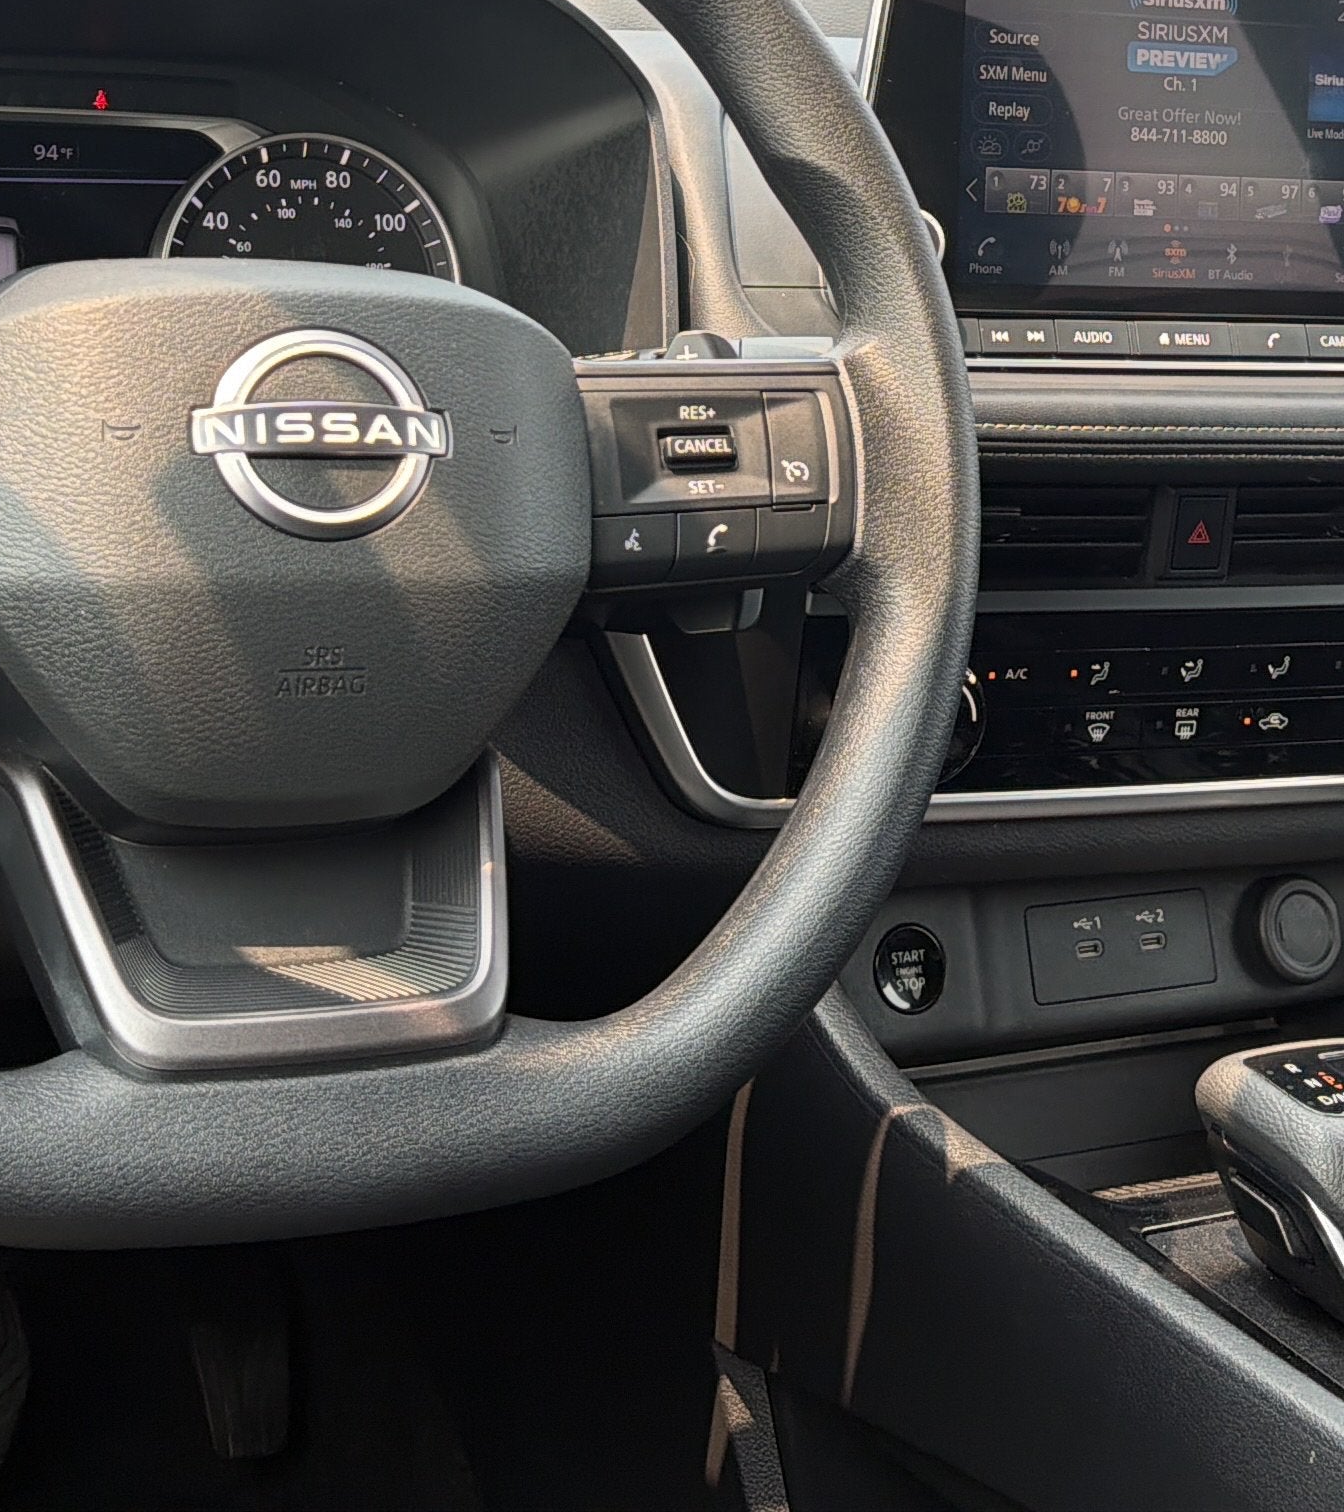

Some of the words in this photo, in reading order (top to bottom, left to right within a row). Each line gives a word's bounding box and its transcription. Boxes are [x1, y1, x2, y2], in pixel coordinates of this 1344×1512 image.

[989, 29, 1040, 46] Source
[1138, 21, 1228, 44] SIRIUSXM
[1136, 49, 1228, 70] PREVIEW
[979, 65, 1008, 80] SXM
[1011, 67, 1047, 83] Menu
[1164, 77, 1186, 92] Ch.
[1191, 78, 1197, 92] 1
[989, 102, 1031, 121] Replay
[1118, 106, 1157, 122] Great
[1162, 108, 1200, 124] Offer
[1205, 110, 1241, 126] Now!
[1130, 127, 1228, 146] 844-711-8800
[1307, 128, 1323, 140] Live
[256, 169, 281, 188] 60
[290, 179, 317, 190] MPH
[325, 171, 351, 188] 80
[993, 176, 999, 187] 1
[1029, 175, 1048, 191] 73
[1057, 179, 1065, 190] 2
[1103, 177, 1112, 192] 7
[1122, 181, 1129, 192] 3
[1157, 180, 1175, 195] 93
[1185, 184, 1192, 194] 4
[1220, 182, 1237, 198] 94
[1247, 186, 1254, 197] 5
[1281, 185, 1298, 200] 97
[1308, 188, 1316, 199] 6
[202, 211, 229, 230] 40
[276, 208, 296, 219] 100
[334, 218, 352, 229] 140
[374, 213, 406, 232] 100
[236, 241, 252, 253] 60
[969, 262, 1003, 274] Phone
[1049, 265, 1068, 276] AM
[1109, 267, 1125, 277] FM
[1152, 268, 1196, 279] SiriusXM
[1209, 269, 1221, 279] BT
[1223, 269, 1253, 280] Audio
[1073, 331, 1113, 344] AUDIO
[1174, 333, 1211, 346] MENU
[679, 405, 716, 420] RES+
[205, 412, 441, 449] NISSAN
[674, 438, 732, 454] CANCEL
[688, 480, 725, 495] SET-
[303, 646, 345, 667] SRS
[1006, 668, 1028, 680] A/C
[274, 675, 367, 698] AIRBAG
[1085, 710, 1116, 720] FRONT
[1175, 708, 1199, 717] REAR
[1095, 916, 1102, 929] 1
[1156, 908, 1164, 923] 2
[891, 948, 926, 965] START
[895, 966, 923, 976] ENGINE
[896, 977, 926, 992] STOP
[1283, 1063, 1302, 1074] R
[1303, 1077, 1323, 1089] N
